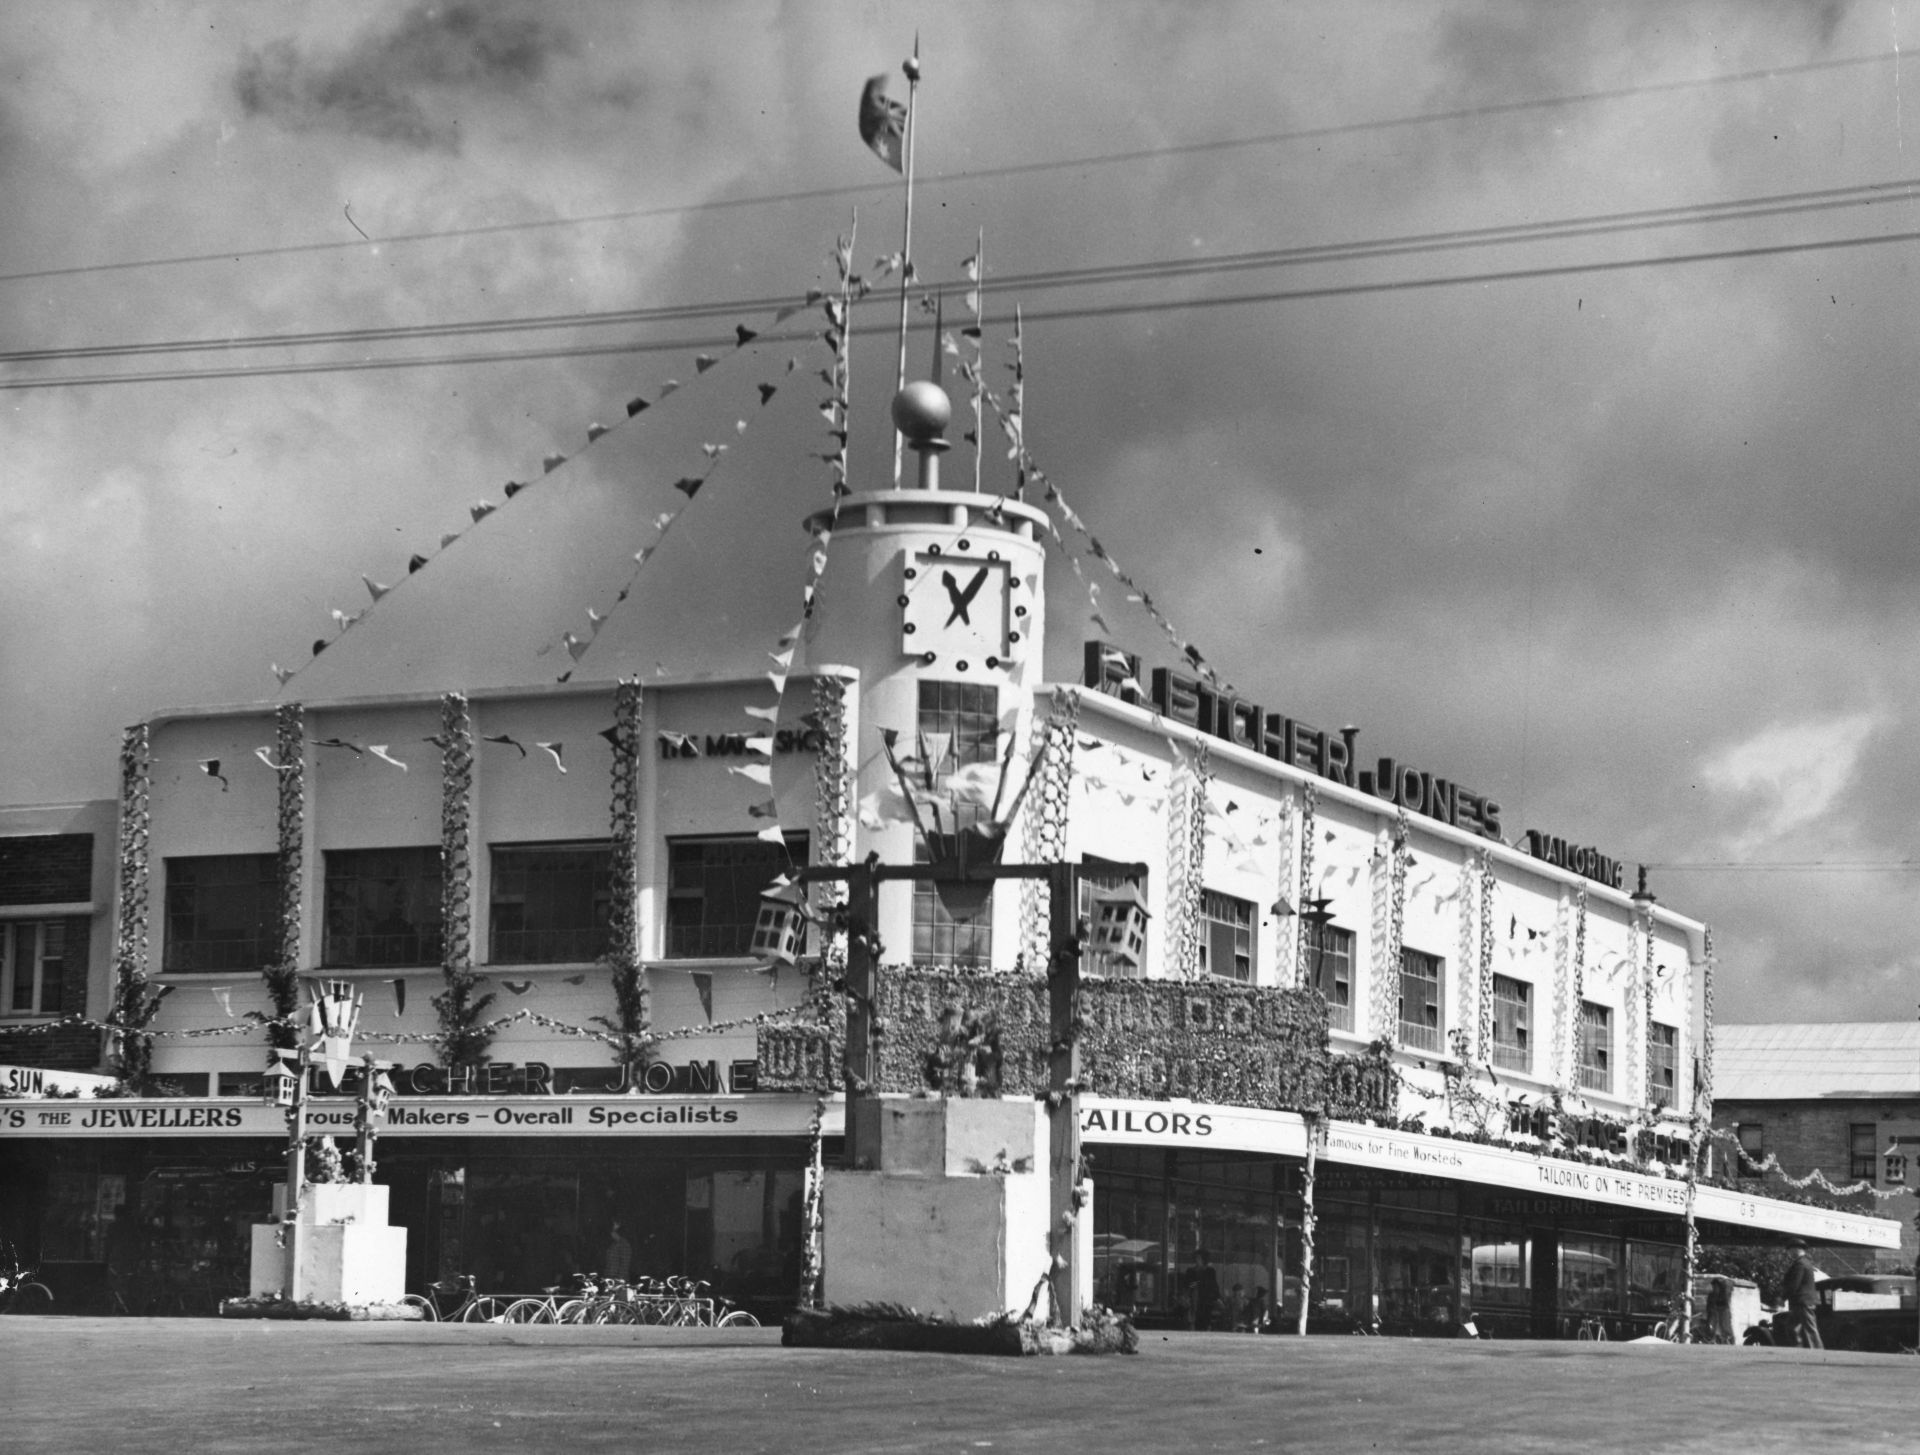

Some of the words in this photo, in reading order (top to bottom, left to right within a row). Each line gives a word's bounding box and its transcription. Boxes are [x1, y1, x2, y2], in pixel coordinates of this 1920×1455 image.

[1358, 758, 1503, 841] JONES
[1526, 829, 1624, 889] TAILORING
[9, 1069, 43, 1094] SUN
[38, 1112, 71, 1126] THE
[81, 1107, 243, 1128] JEWELLERS
[388, 1107, 470, 1125] Makers
[494, 1107, 573, 1125] Overall
[588, 1106, 738, 1128] Specialists
[1083, 1108, 1212, 1136] AILORS
[1368, 1141, 1383, 1154] for
[1388, 1142, 1409, 1159] Fine
[1413, 1146, 1464, 1167] Worsteds
[1538, 1166, 1588, 1190] TAILORING
[1596, 1177, 1608, 1192] ON
[1615, 1179, 1632, 1198] THE
[1638, 1182, 1687, 1207] PREMISES
